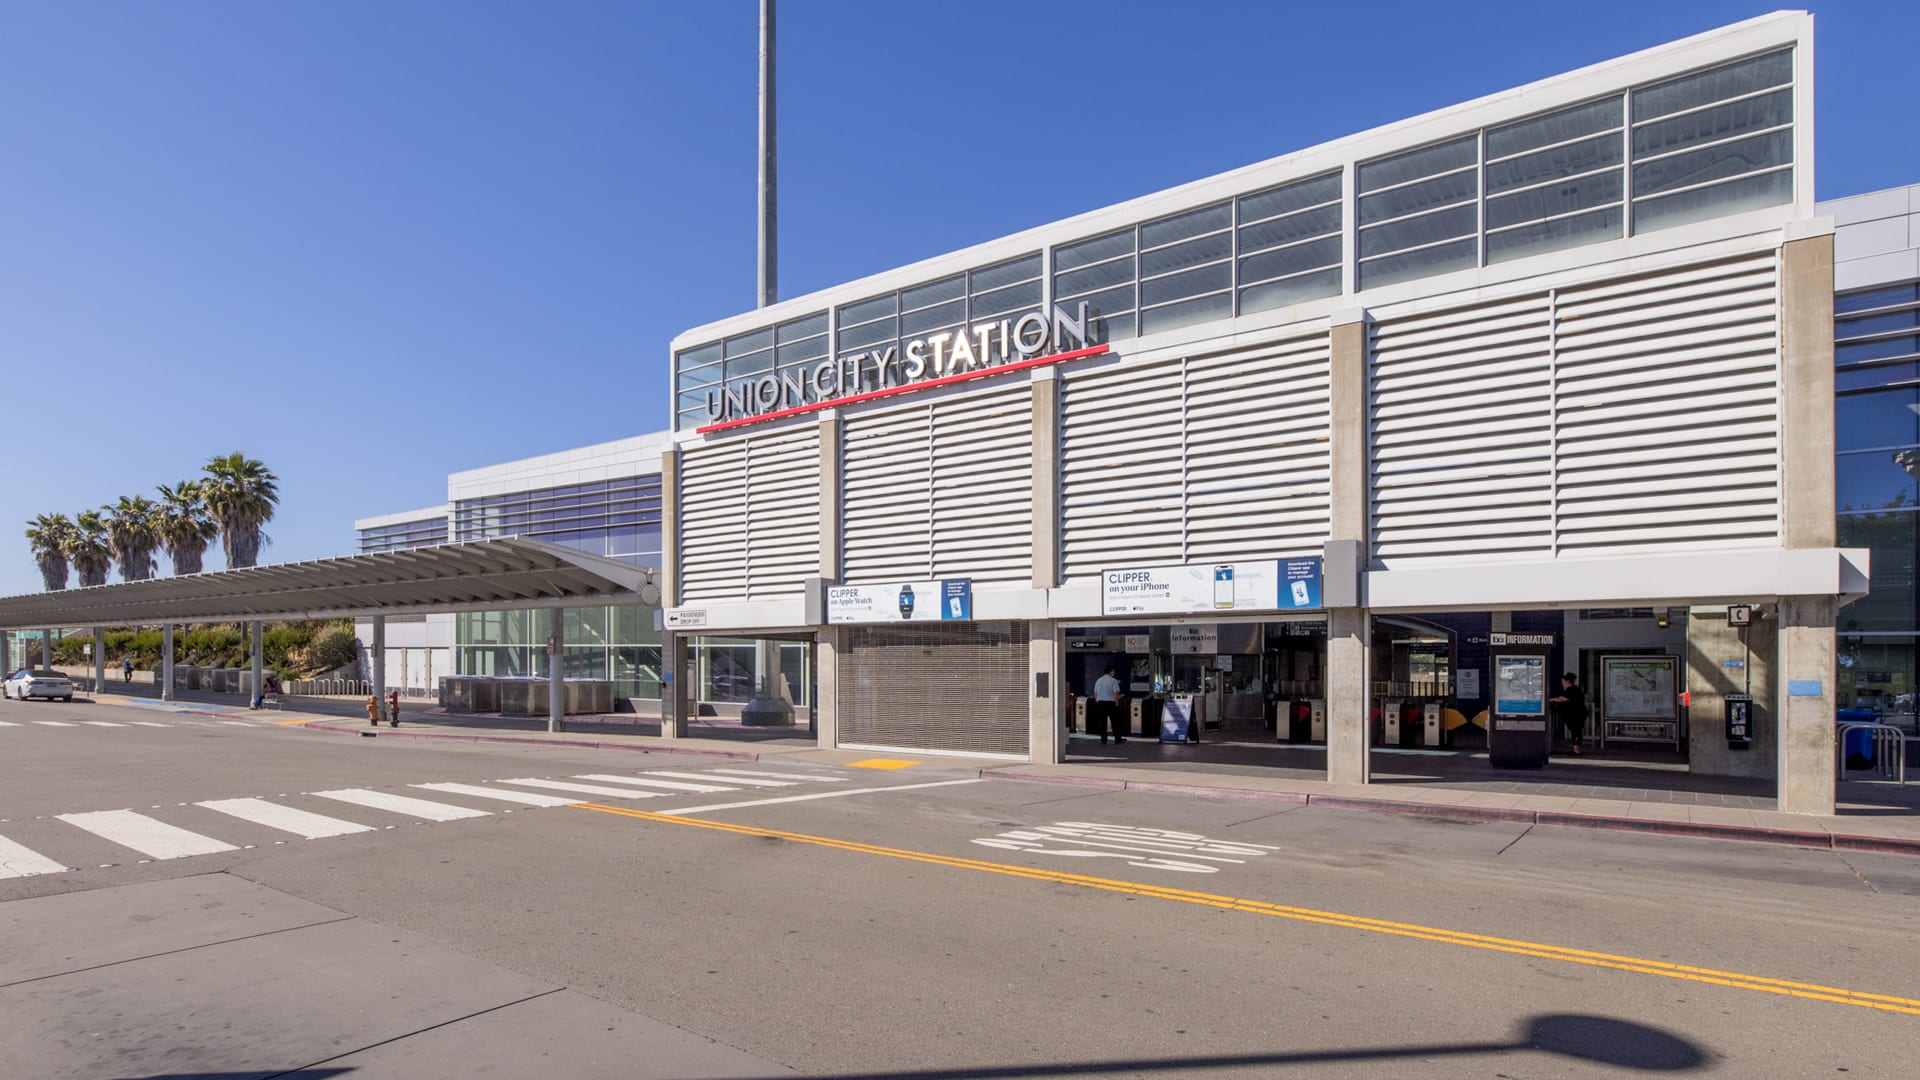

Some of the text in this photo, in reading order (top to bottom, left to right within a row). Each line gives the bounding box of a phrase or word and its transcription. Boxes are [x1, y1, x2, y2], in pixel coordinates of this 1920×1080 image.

[705, 301, 1090, 421] UNION CITY STATION
[1109, 571, 1150, 584] CLIPPER
[831, 589, 859, 598] CLIPPER
[1121, 584, 1139, 594] your
[1140, 582, 1170, 591] iPhone
[839, 598, 854, 606] Apple
[1507, 635, 1553, 645] INFORMATION
